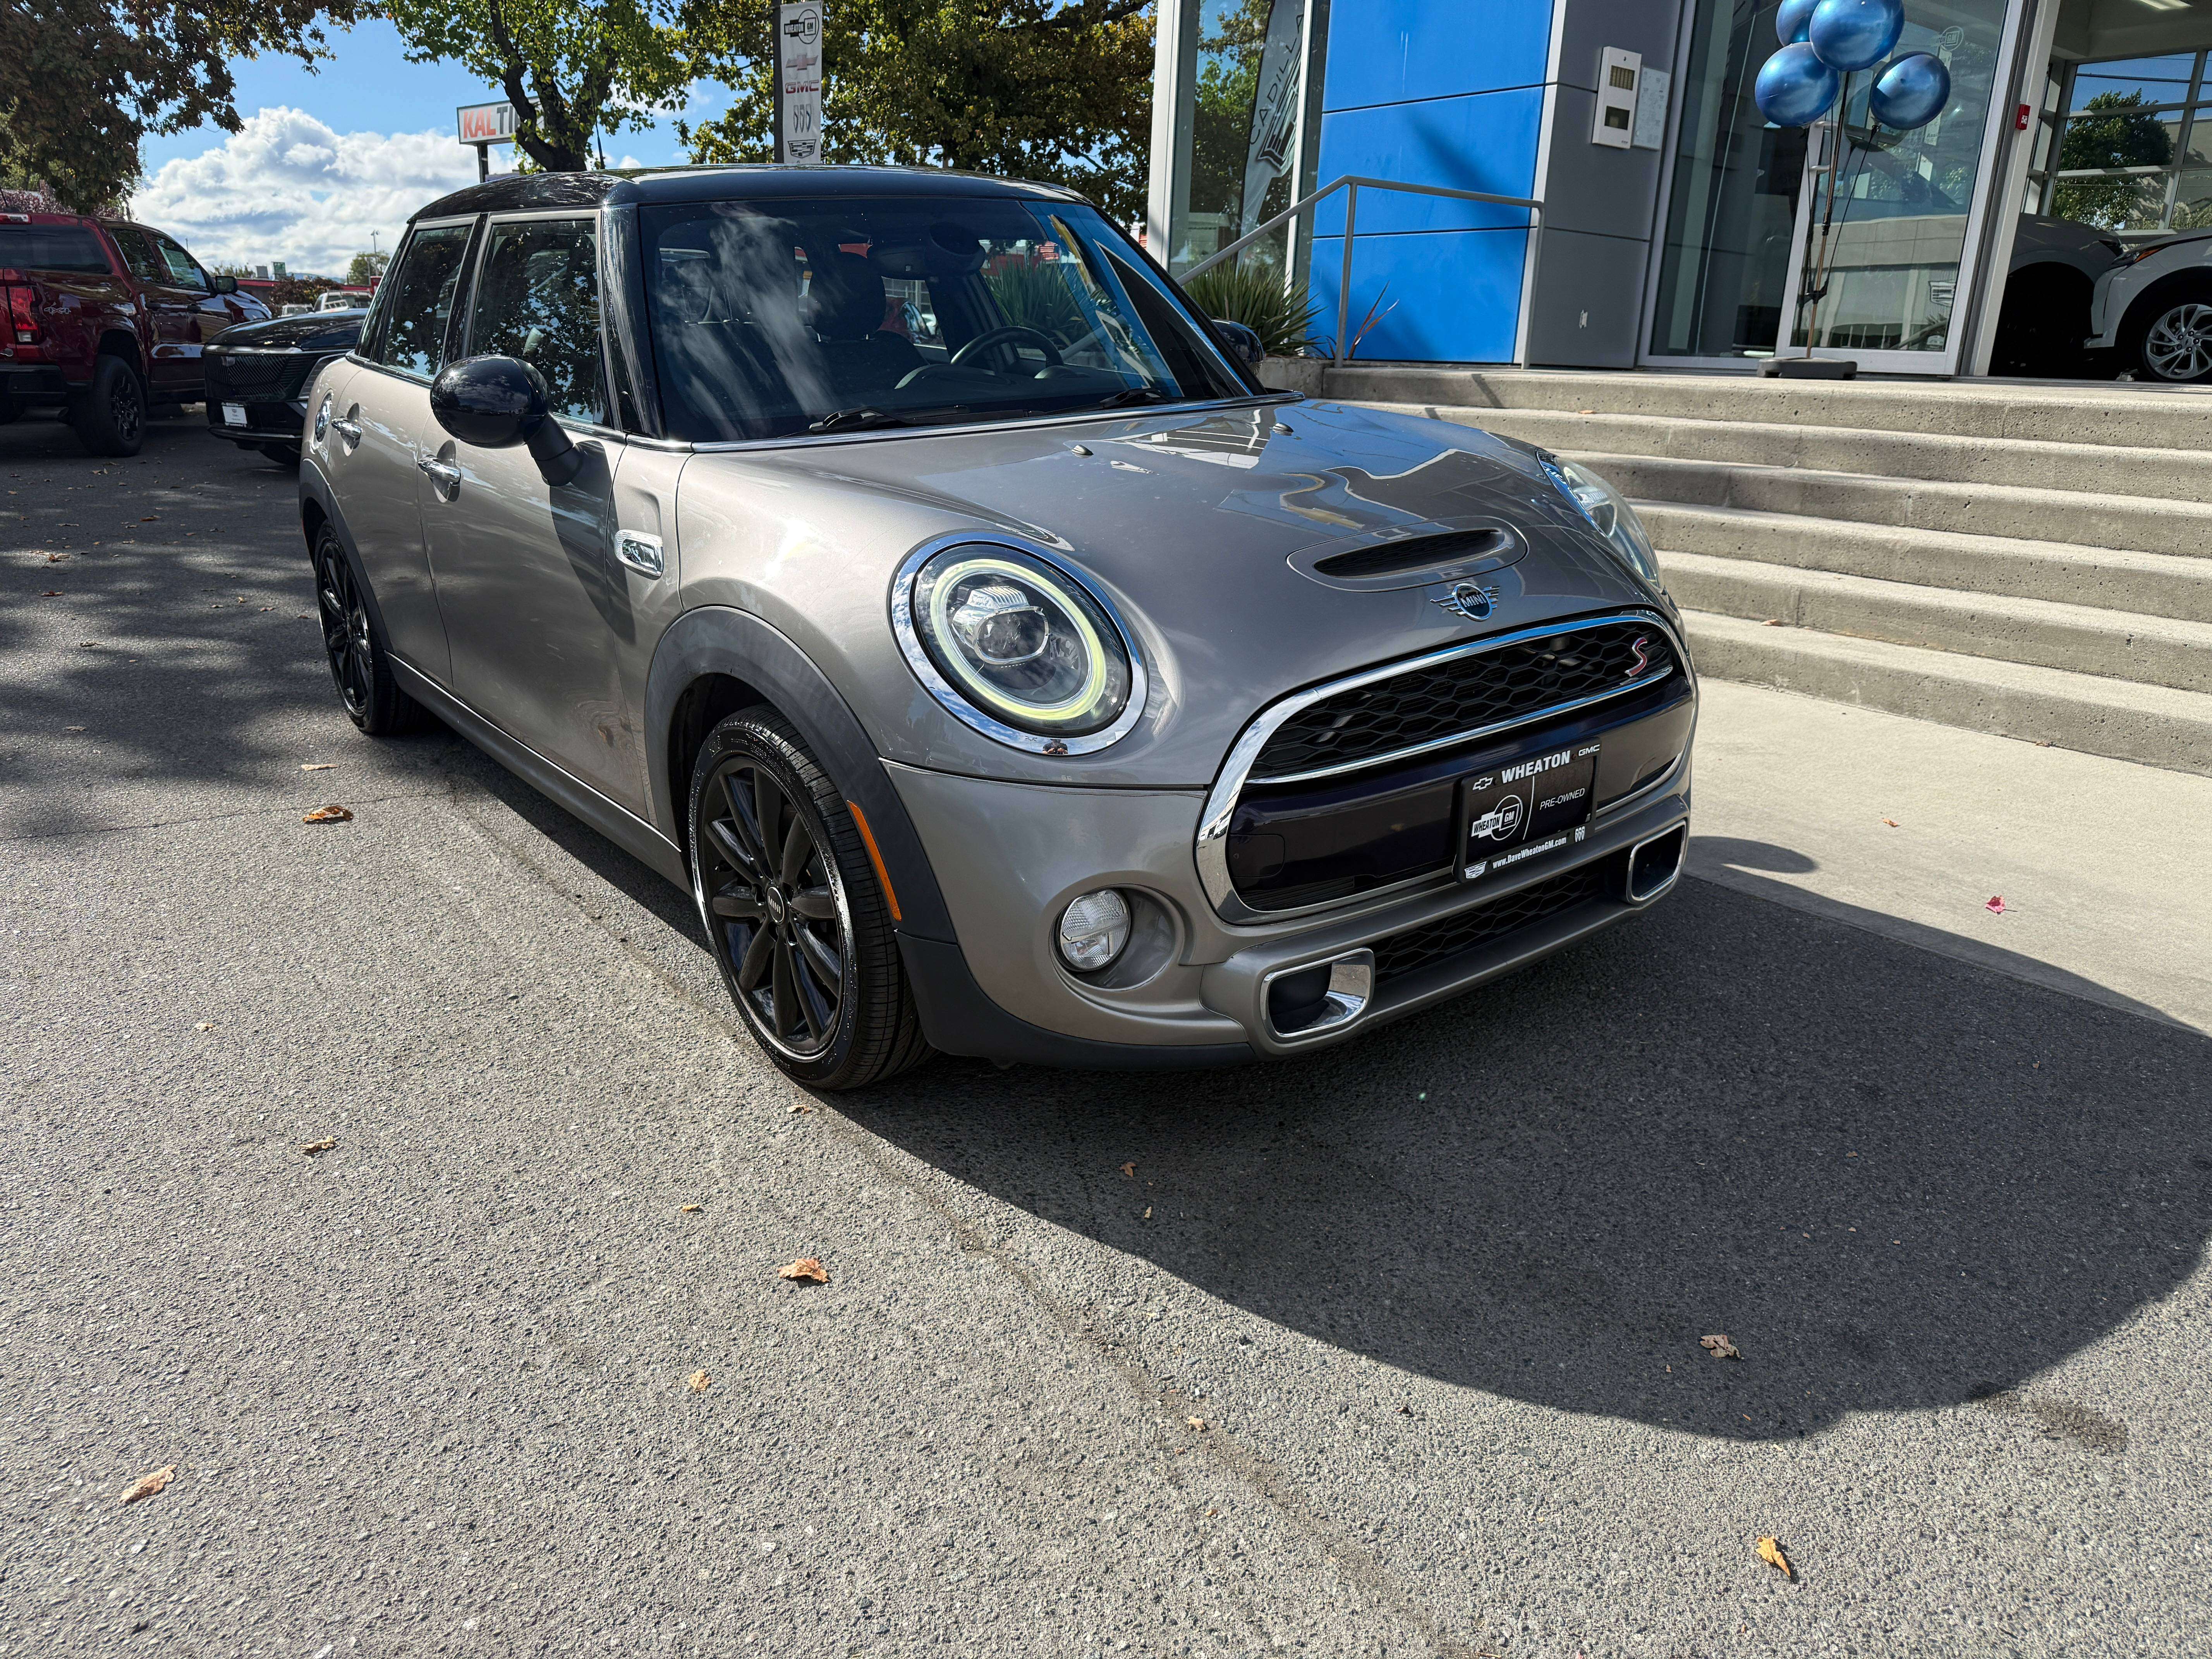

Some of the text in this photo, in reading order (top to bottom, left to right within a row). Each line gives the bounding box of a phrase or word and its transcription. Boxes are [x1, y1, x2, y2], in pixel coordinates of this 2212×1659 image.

[785, 24, 804, 34] WHEATON
[785, 80, 819, 94] GMC
[1460, 594, 1486, 607] MINI
[1625, 637, 1648, 677] S
[1501, 744, 1600, 784] WHEATON GMC
[1539, 788, 1585, 810] PRE-OWNED
[1474, 810, 1515, 834] WHEATON GM
[1492, 837, 1566, 869] www.DaveWheatonGM.com
[768, 895, 781, 914] MINI
